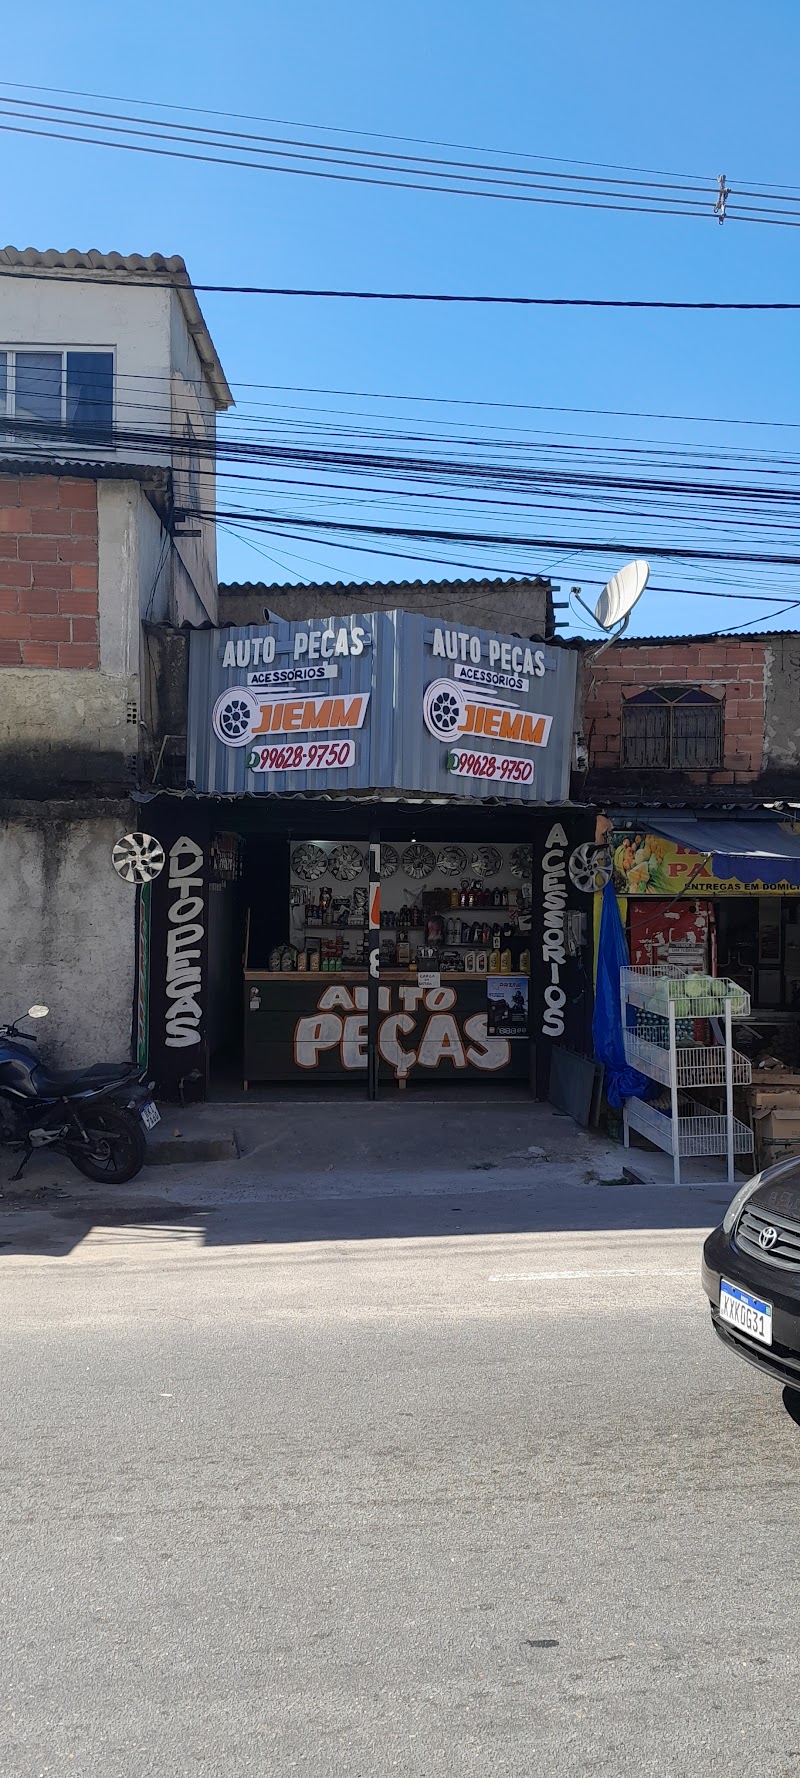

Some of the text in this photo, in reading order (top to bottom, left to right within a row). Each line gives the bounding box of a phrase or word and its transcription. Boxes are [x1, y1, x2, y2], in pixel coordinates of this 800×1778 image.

[222, 636, 276, 668] AUTO
[432, 628, 546, 678] AUTO PEÇAS
[252, 697, 363, 733] JIEMM
[458, 705, 546, 743] JIEMM
[259, 743, 351, 769] 99628-9750
[459, 755, 533, 782] 99628-9750
[318, 985, 456, 1011] AUTO
[293, 1012, 511, 1079] PEÇAS
